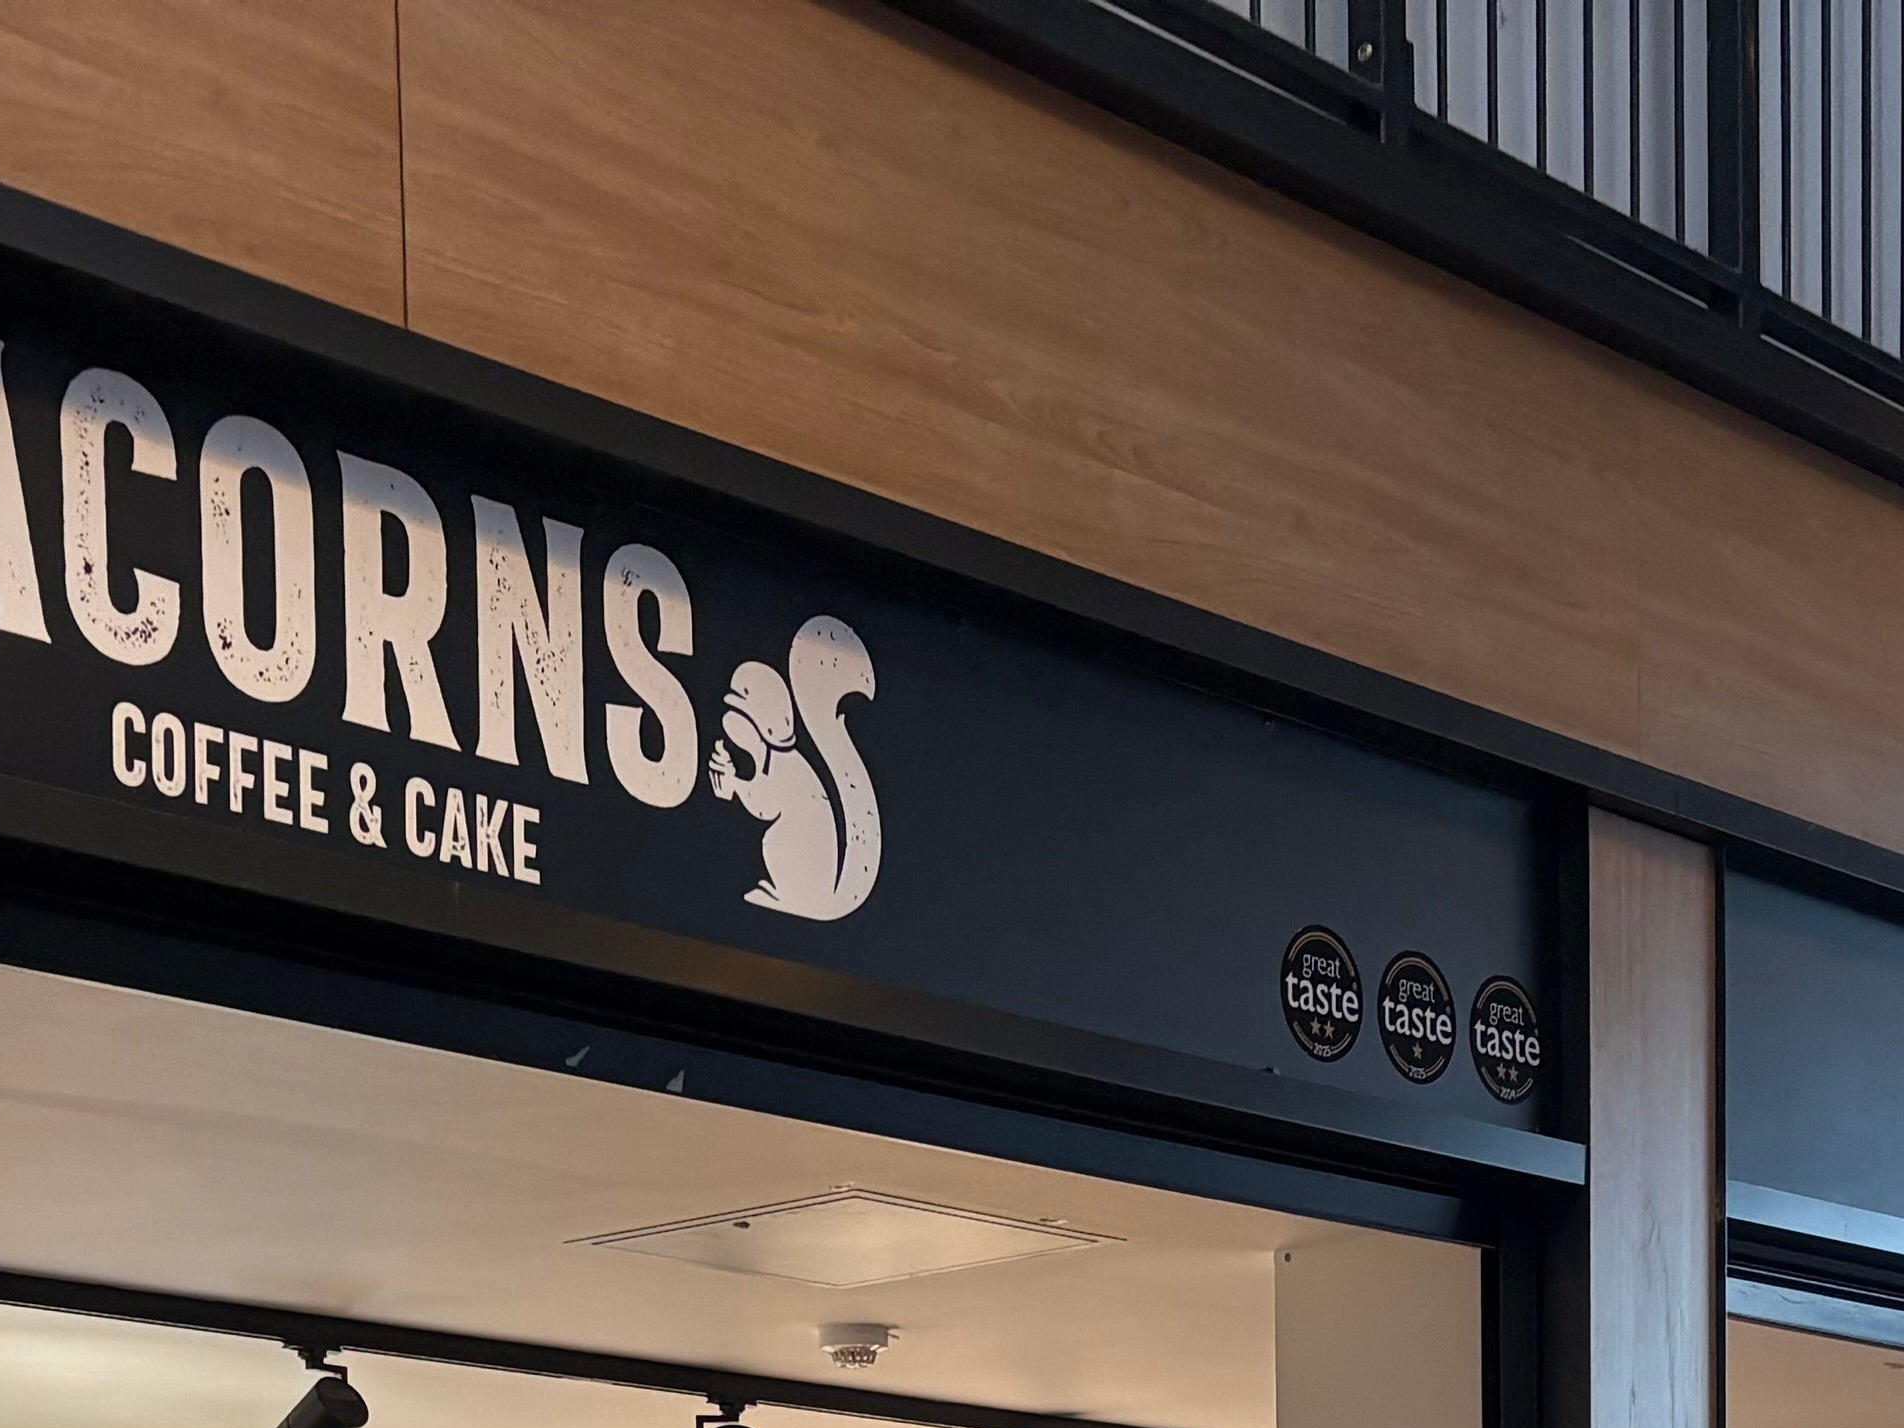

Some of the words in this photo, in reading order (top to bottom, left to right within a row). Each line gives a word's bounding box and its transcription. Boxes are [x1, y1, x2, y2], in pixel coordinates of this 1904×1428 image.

[112, 701, 327, 832] COFFEE
[348, 761, 387, 847] &
[405, 775, 541, 885] CAKE
[1302, 953, 1341, 978] great
[1285, 970, 1359, 1022] taste
[1399, 978, 1436, 1003] great
[1490, 1002, 1524, 1026] great
[1382, 996, 1452, 1045] taste
[1474, 1019, 1540, 1066] taste
